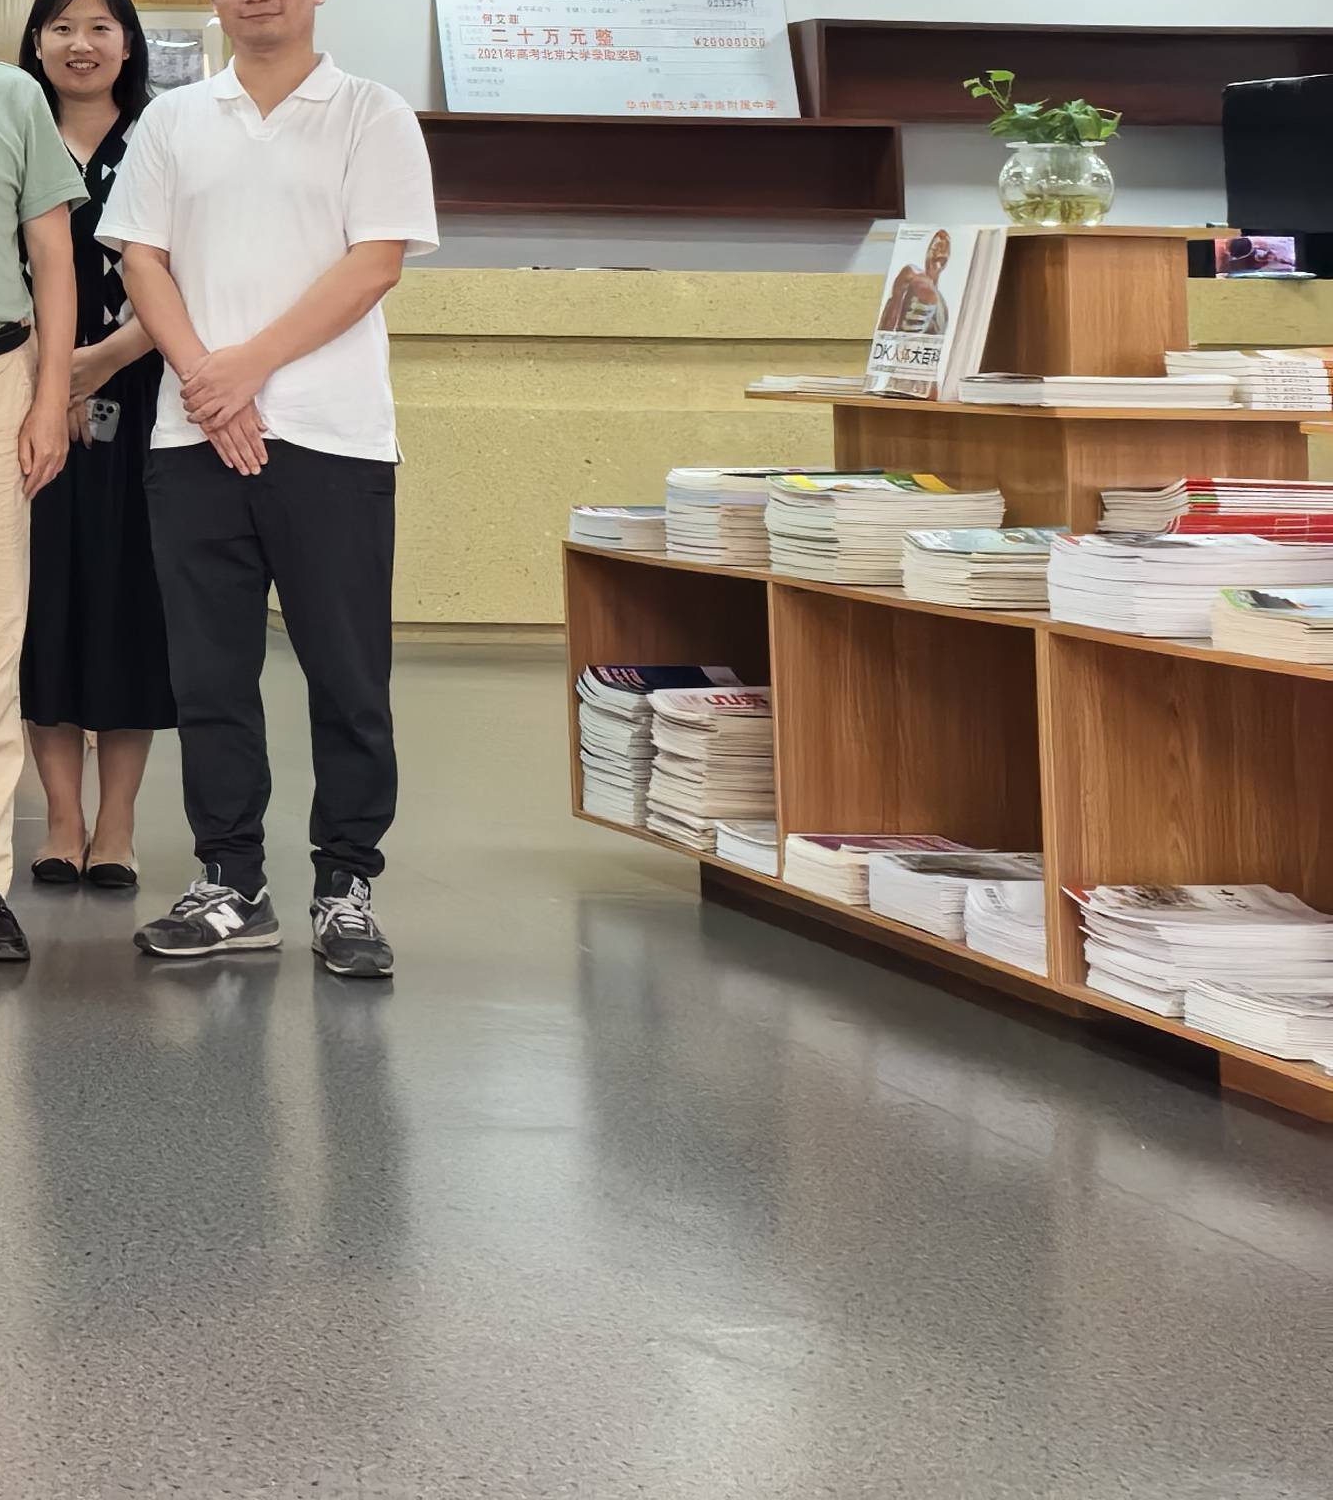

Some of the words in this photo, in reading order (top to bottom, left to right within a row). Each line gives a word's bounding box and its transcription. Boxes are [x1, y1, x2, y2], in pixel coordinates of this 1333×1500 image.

[492, 28, 614, 46] 二十万元整
